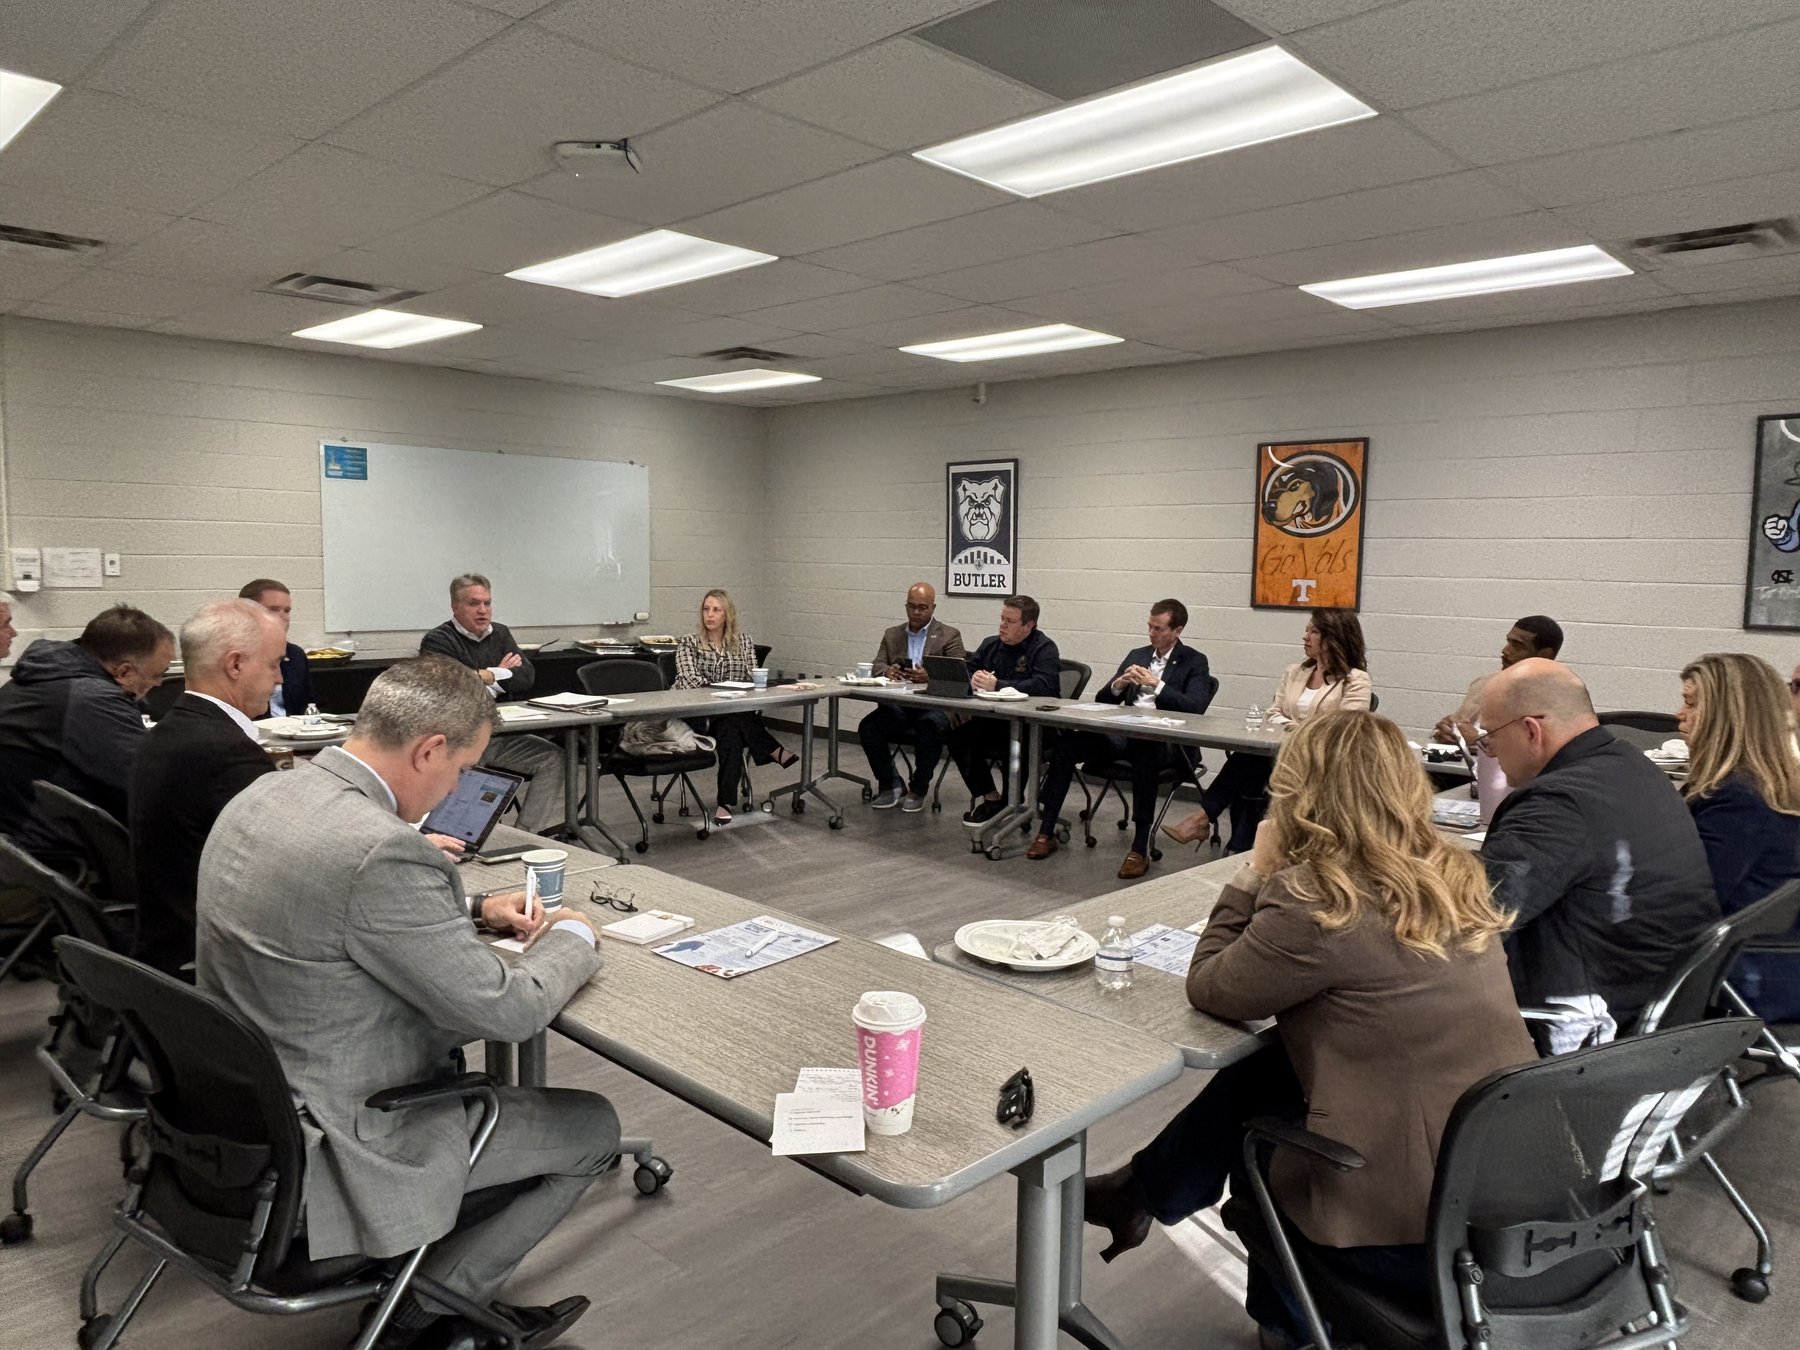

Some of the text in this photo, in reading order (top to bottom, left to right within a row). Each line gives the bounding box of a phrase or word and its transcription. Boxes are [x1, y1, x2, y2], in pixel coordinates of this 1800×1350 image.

[1261, 544, 1296, 576] Go
[953, 572, 1007, 588] BUTLER
[1291, 578, 1317, 602] T
[863, 1035, 879, 1106] DUNKIN'
